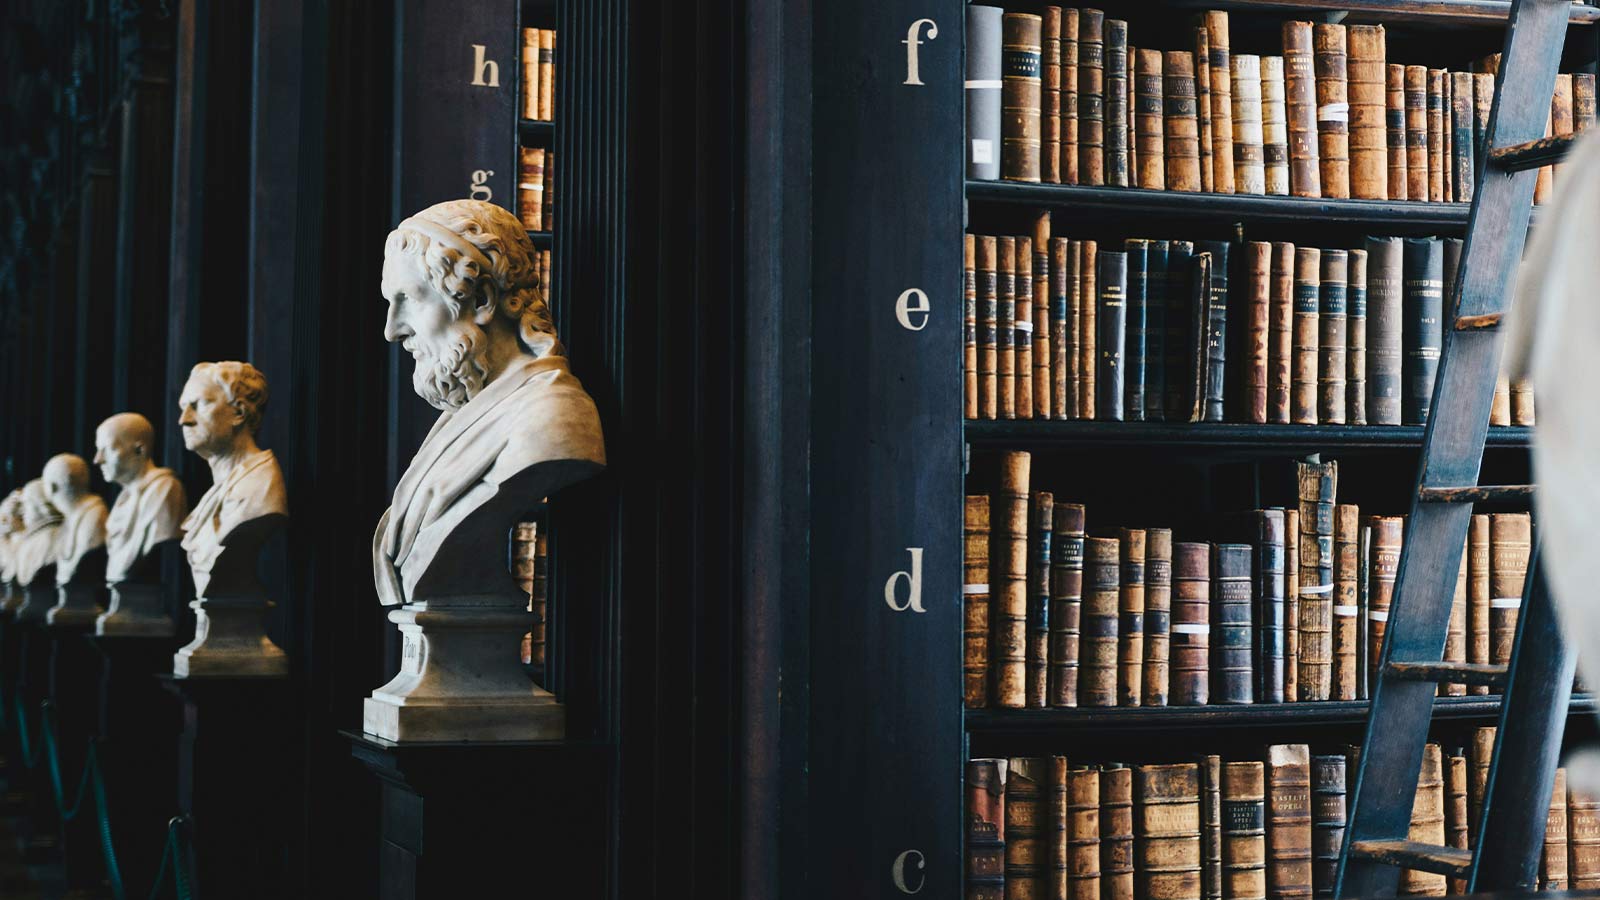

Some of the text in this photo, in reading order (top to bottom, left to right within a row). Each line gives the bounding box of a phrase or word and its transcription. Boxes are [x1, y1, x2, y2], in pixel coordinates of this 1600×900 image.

[470, 44, 500, 88] h
[901, 18, 939, 86] f
[469, 169, 495, 202] g
[895, 287, 931, 332] e
[884, 547, 927, 613] d
[892, 849, 926, 895] c
